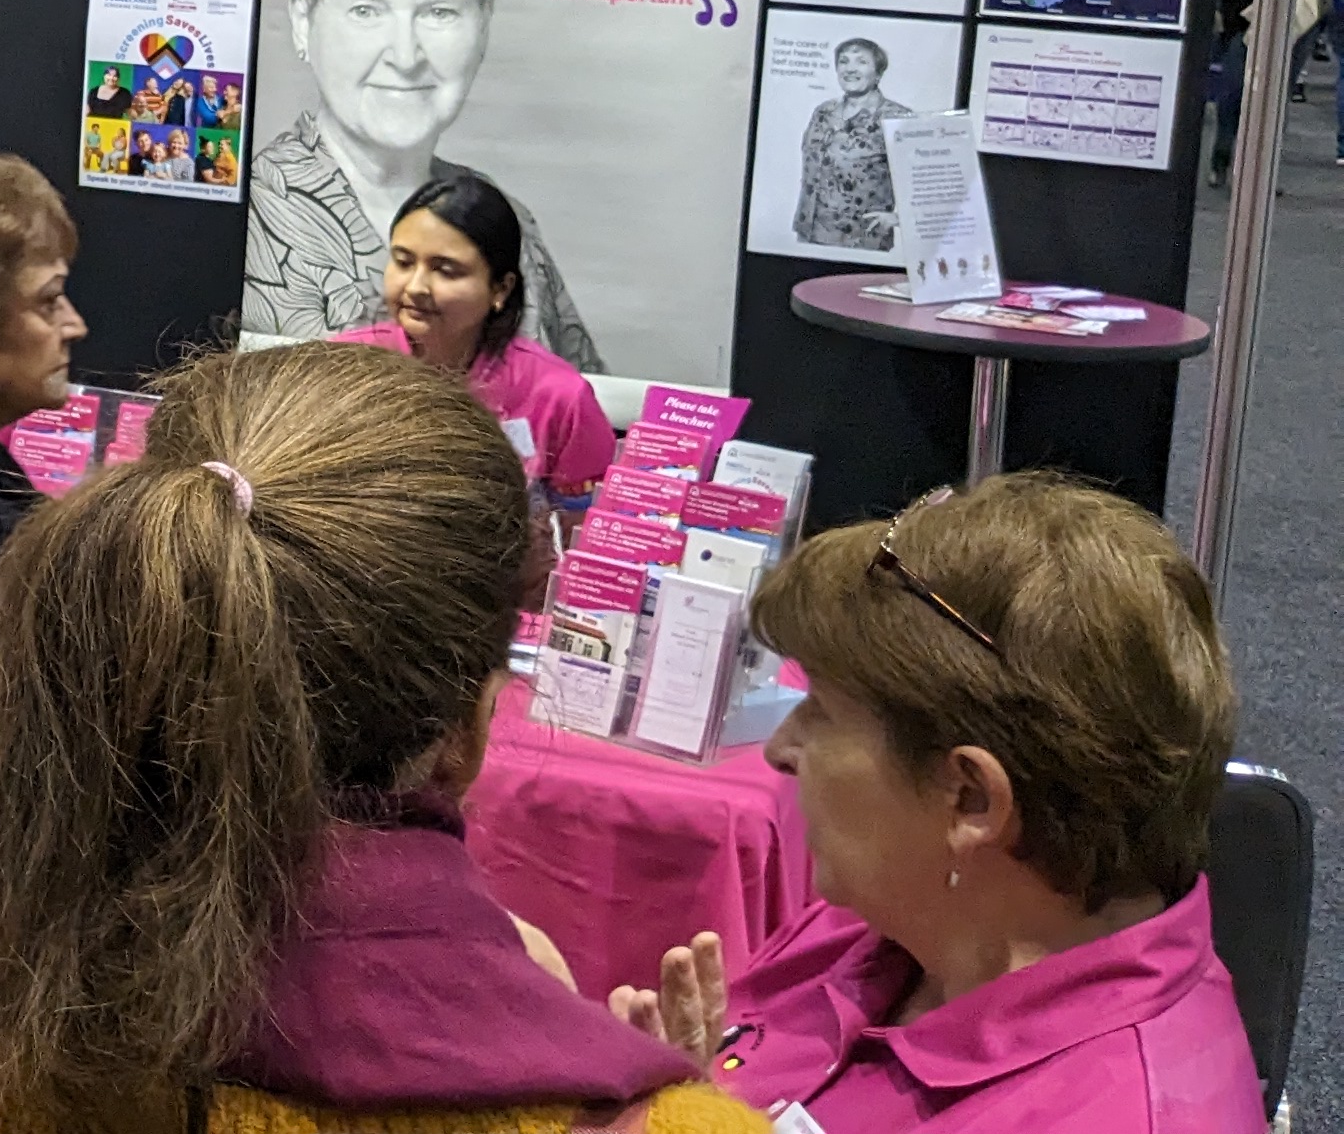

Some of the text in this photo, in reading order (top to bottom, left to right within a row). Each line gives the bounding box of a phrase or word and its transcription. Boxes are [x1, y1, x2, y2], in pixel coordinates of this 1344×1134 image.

[115, 14, 215, 69] Screening Saves Lives
[664, 396, 720, 416] Please take
[660, 411, 715, 430] a brochure
